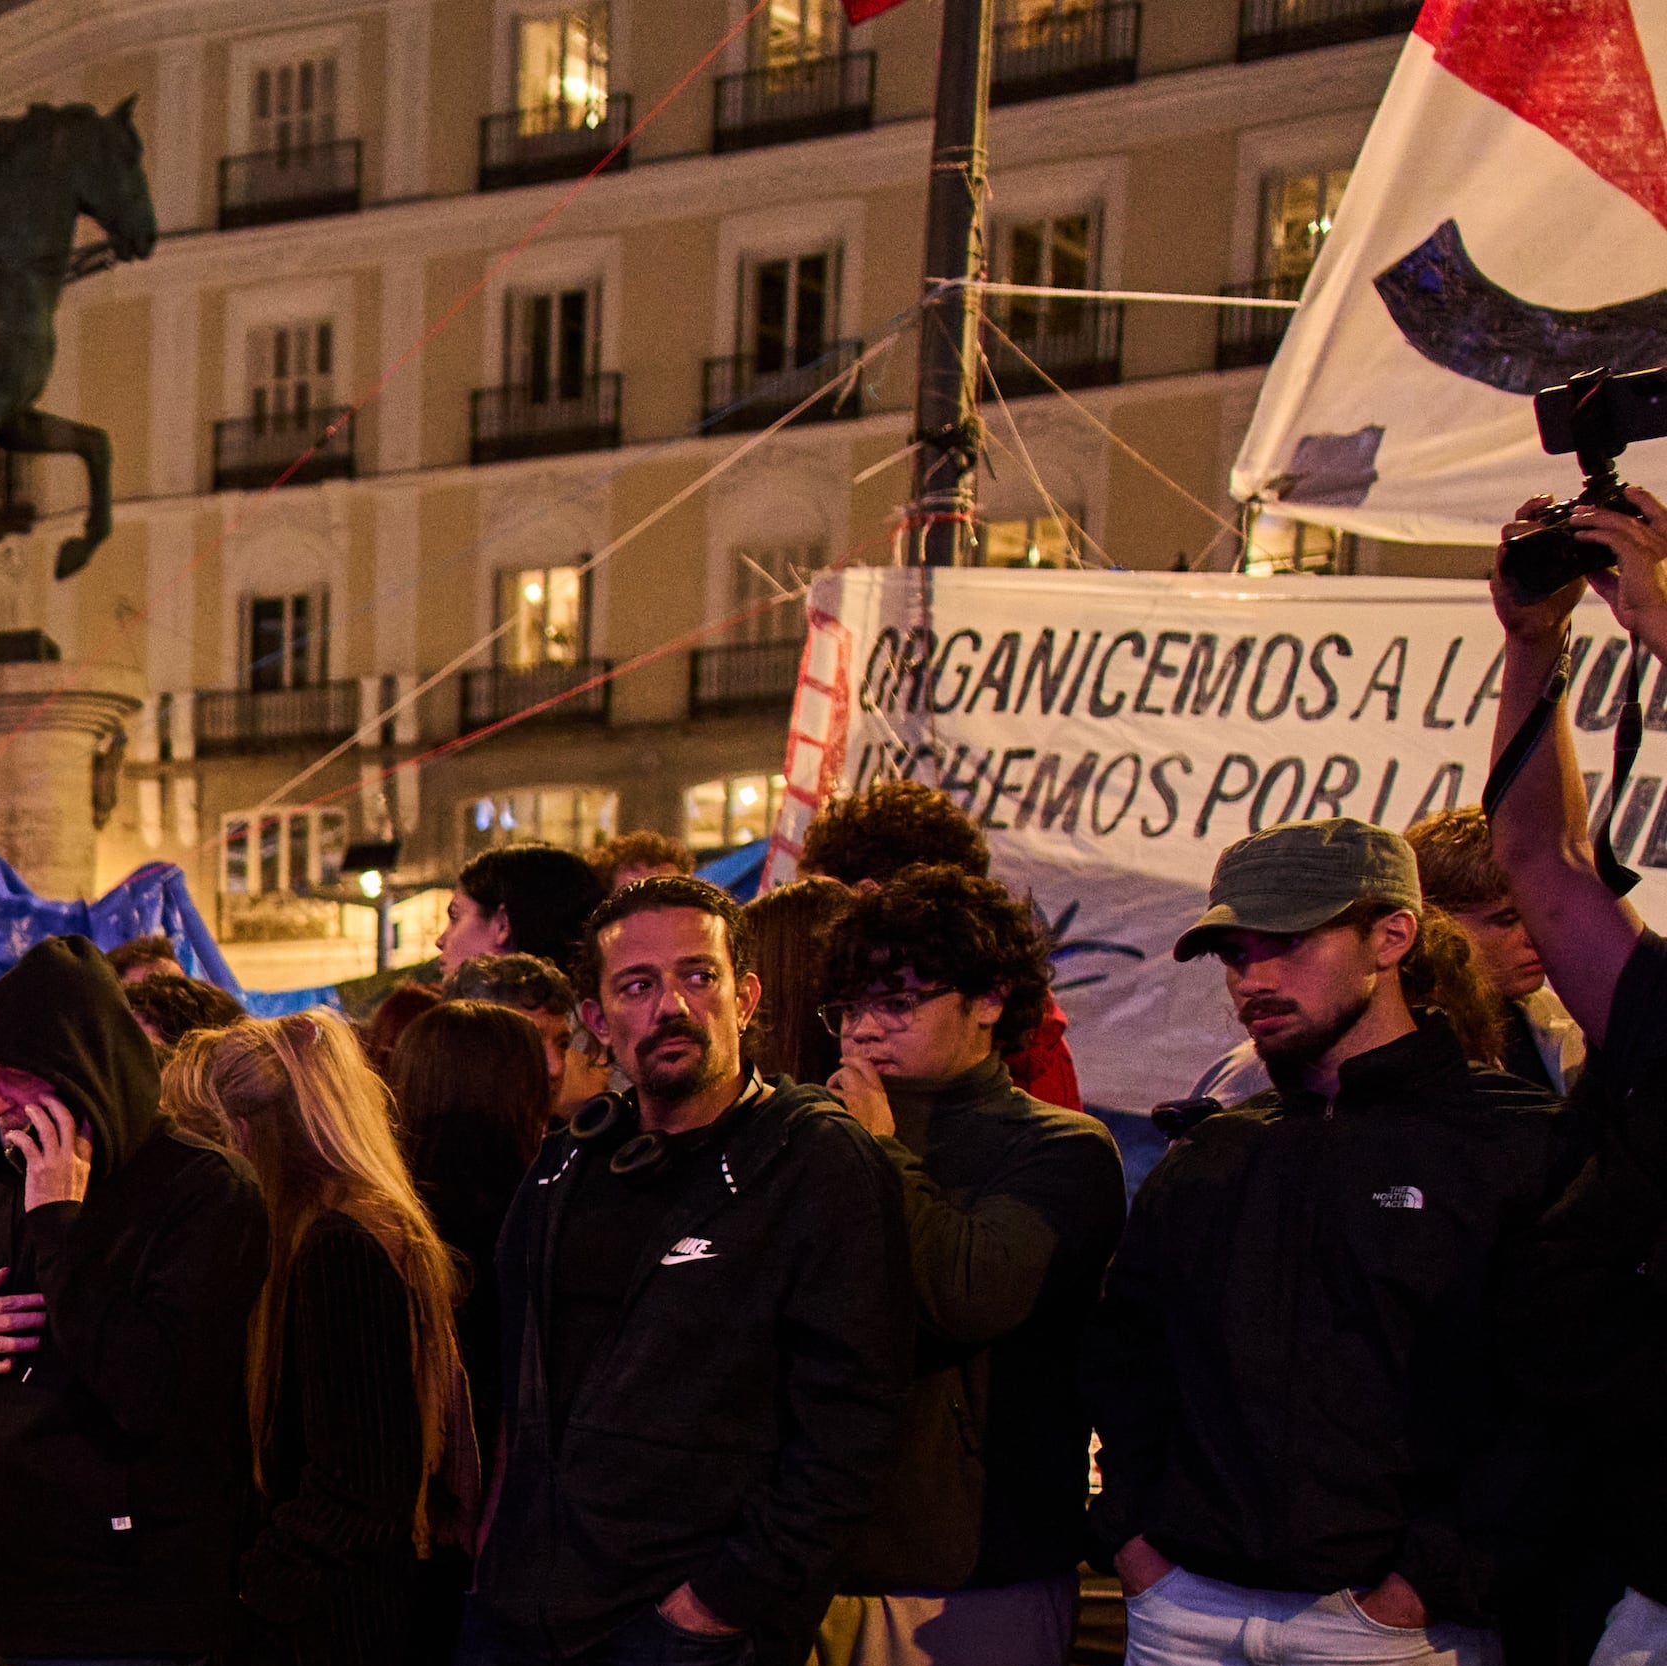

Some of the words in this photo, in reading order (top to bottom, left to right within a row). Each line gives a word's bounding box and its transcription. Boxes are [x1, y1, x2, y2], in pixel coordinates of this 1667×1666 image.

[861, 626, 1355, 722] ORGANICEMOS
[1351, 636, 1409, 722] A
[1372, 1193, 1406, 1201] NORTH
[1379, 1200, 1407, 1208] FACE
[670, 1236, 713, 1254] NIKE
